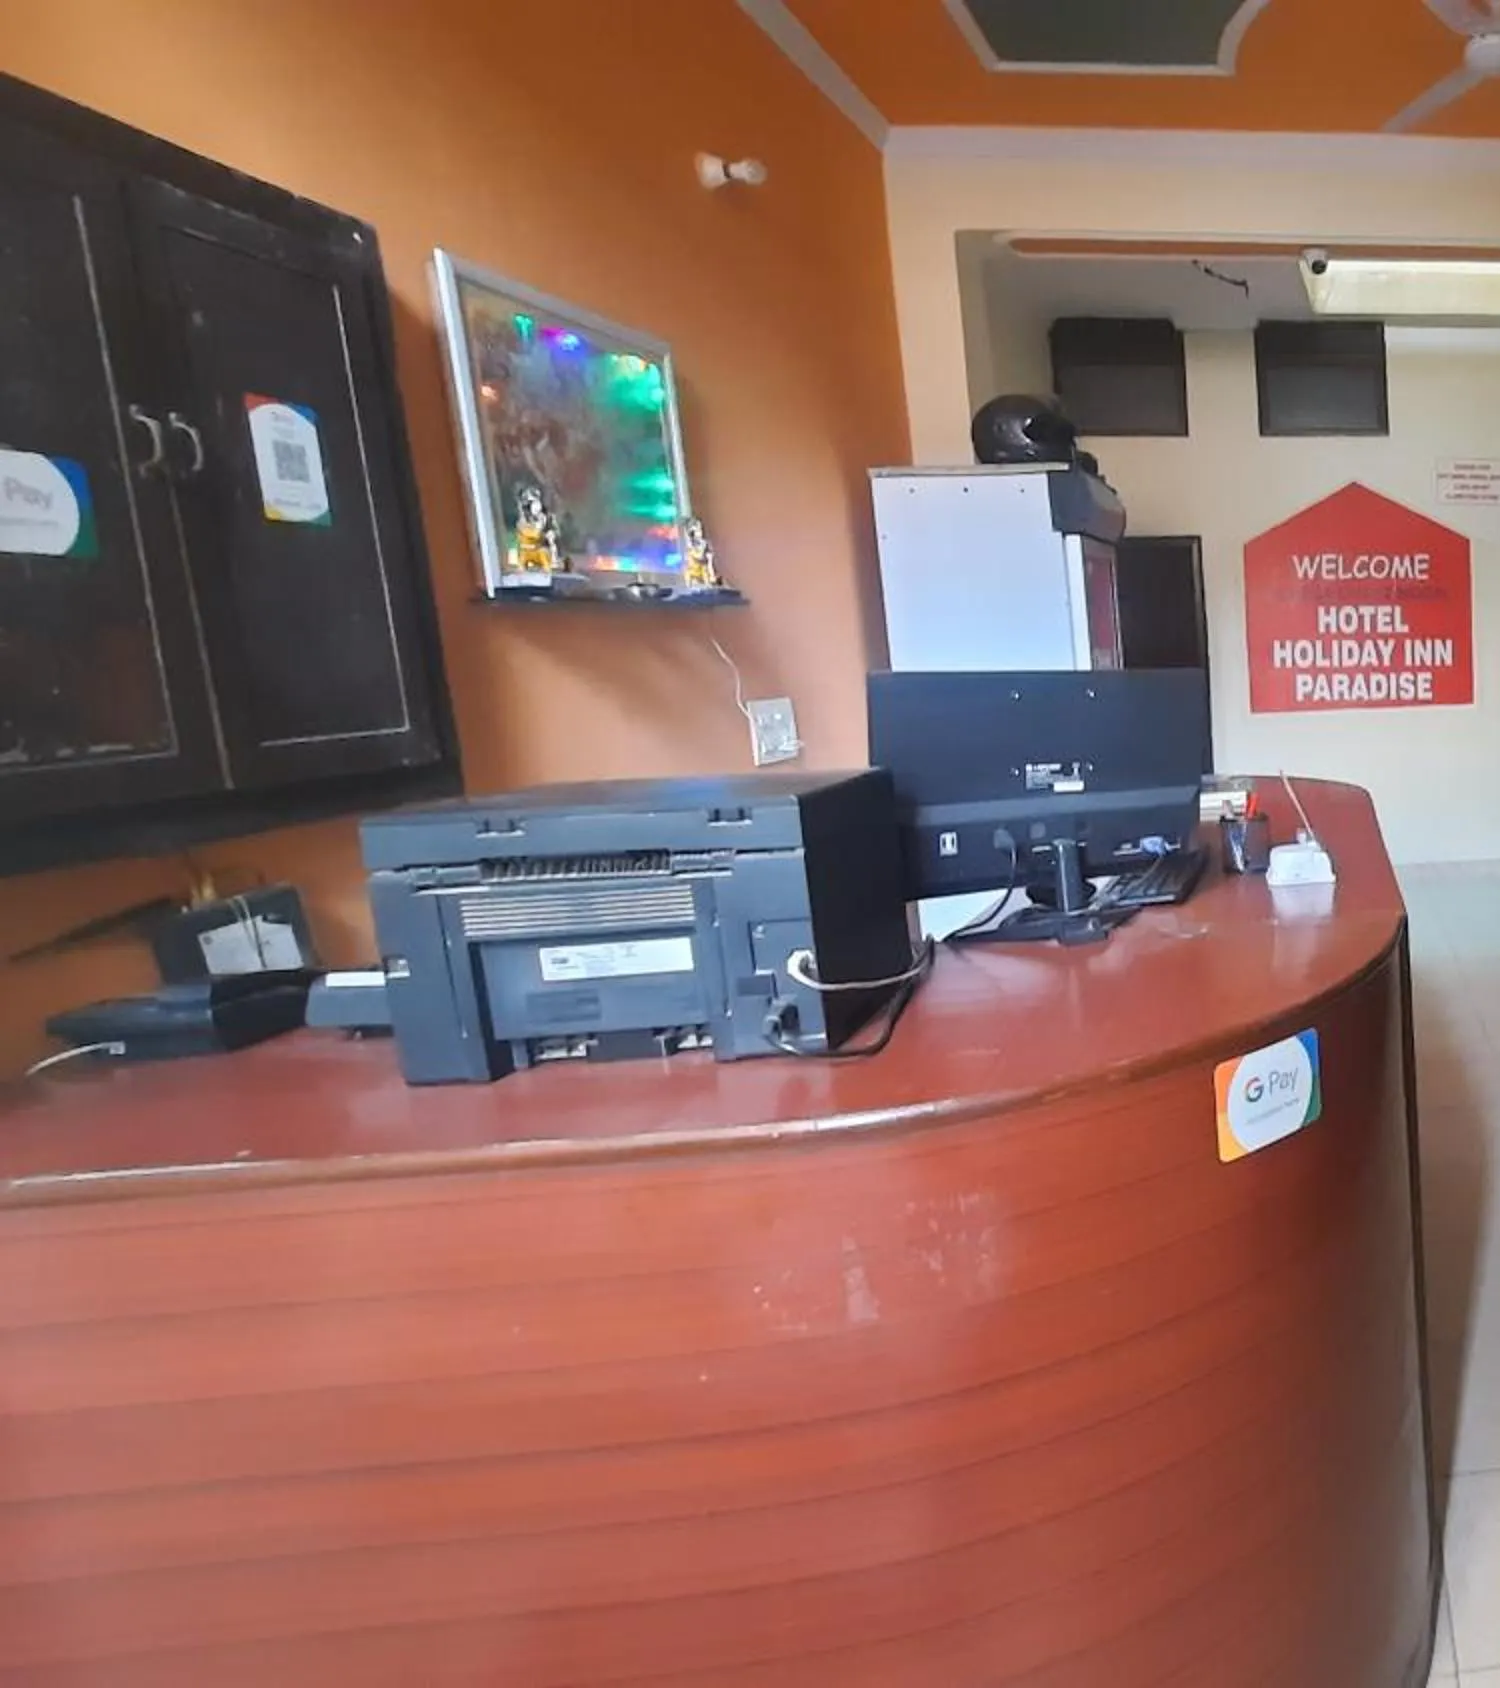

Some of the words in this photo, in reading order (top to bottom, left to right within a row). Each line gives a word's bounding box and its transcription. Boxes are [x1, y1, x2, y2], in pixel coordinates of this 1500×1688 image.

[1293, 553, 1430, 581] WELCOME
[1318, 605, 1409, 634] HOTEL
[1273, 639, 1394, 669] HOLIDAY
[1405, 639, 1453, 667] INN
[1295, 672, 1433, 702] PARADISE
[1245, 1077, 1264, 1102] G
[1268, 1068, 1298, 1096] Pay
